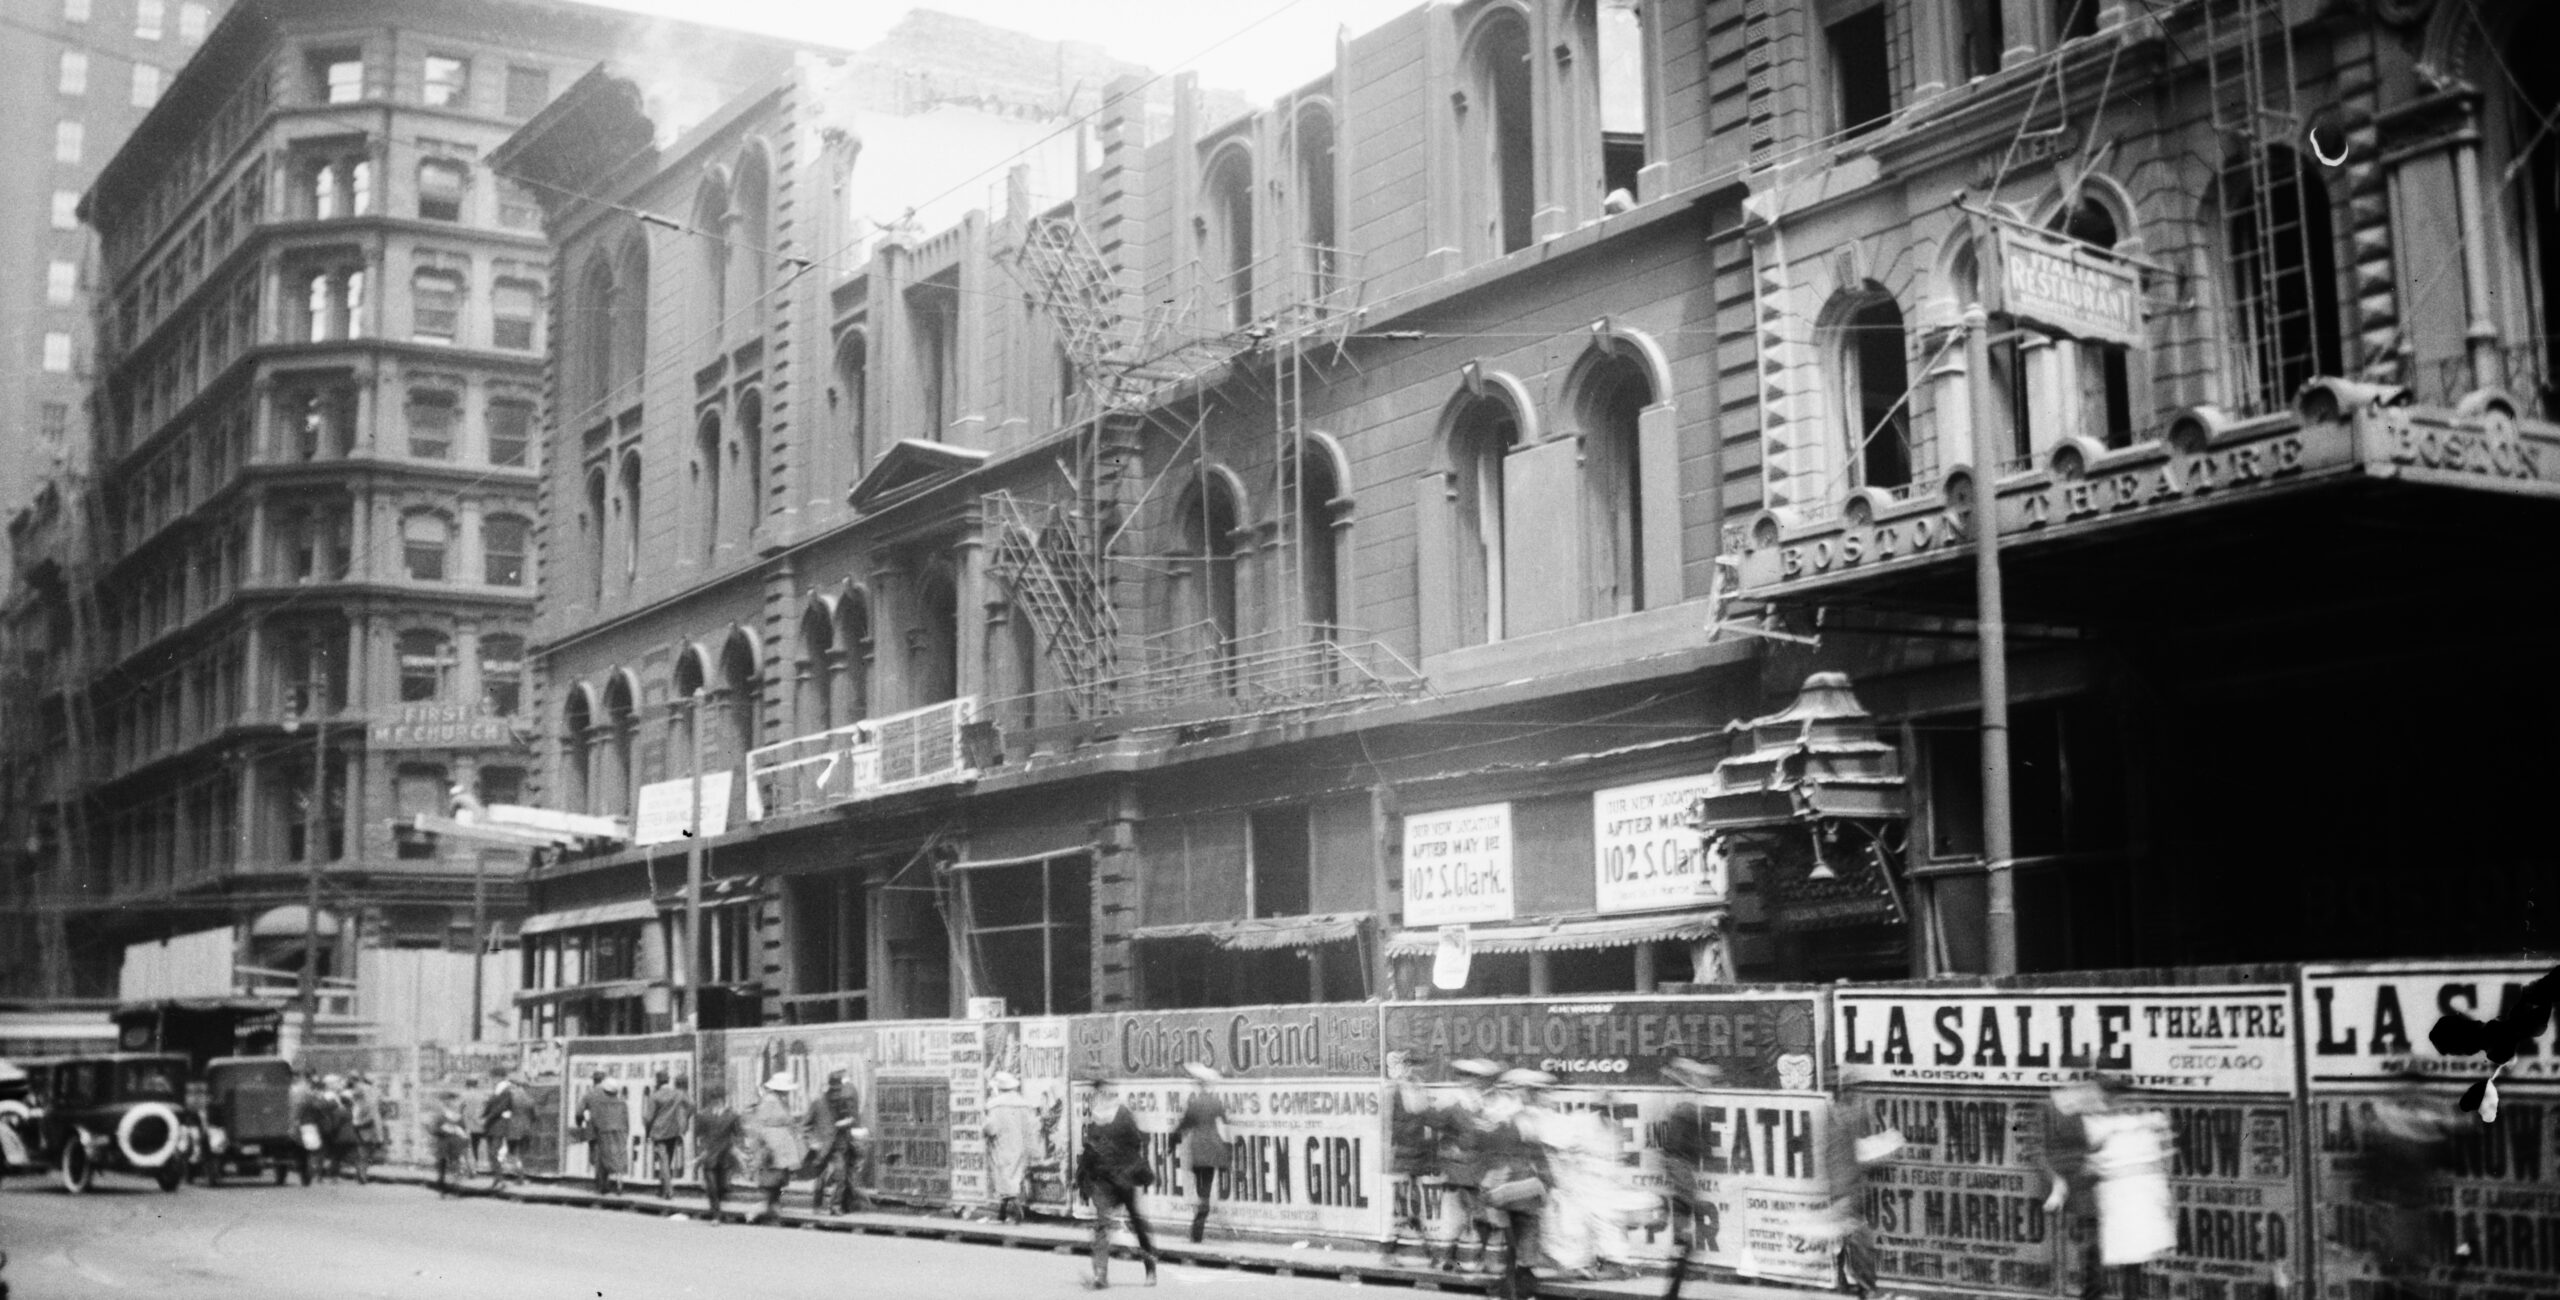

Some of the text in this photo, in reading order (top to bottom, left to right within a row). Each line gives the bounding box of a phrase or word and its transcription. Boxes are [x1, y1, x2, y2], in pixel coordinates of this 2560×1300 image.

[2009, 255, 2131, 322] RESTAURANT
[2030, 253, 2112, 290] ITALIAN
[2389, 423, 2541, 480] BOSTON
[1780, 438, 2302, 583] BOSTON THEATRE
[405, 705, 470, 722] FIRST
[414, 724, 498, 742] CHURCH
[1606, 801, 1628, 816] OUR
[1632, 795, 1656, 810] NEW
[1607, 812, 1690, 836] AFTER MAY
[1412, 841, 1448, 858] AFTER
[1453, 838, 1478, 854] MAY
[1604, 843, 1639, 884] 102
[1643, 841, 1658, 880] S.
[1409, 859, 1506, 902] 102 S. Clark.
[1428, 1013, 1758, 1060] APOLLO THEATRE
[1842, 1005, 2132, 1070] LA SALLE
[2143, 1004, 2286, 1039] THEATRE
[2314, 984, 2412, 1056] LA
[1120, 1012, 1321, 1075] Cohan's Grand
[2168, 1054, 2264, 1071] CHICAGO
[1539, 1057, 1630, 1074] CHICAGO
[1889, 1069, 1985, 1082] MADISON
[1998, 1071, 2024, 1083] AT
[2037, 1071, 2096, 1085] CLAR
[1127, 1090, 1160, 1114] GEO.
[1164, 1090, 1183, 1114] M.
[1268, 1090, 1379, 1117] COMEDIANS
[1697, 1105, 1815, 1179] EATH
[1943, 1100, 2007, 1165] NOW
[2171, 1107, 2244, 1179] NOW
[1302, 1135, 1368, 1209] GIRL
[1911, 1169, 1944, 1186] FEAST
[1949, 1172, 1962, 1188] OF
[1965, 1172, 2024, 1192] LAUGHTER
[1391, 1181, 1443, 1221] NOW
[1864, 1187, 2046, 1244] UST MARRIED
[2176, 1206, 2287, 1263] ARRIED
